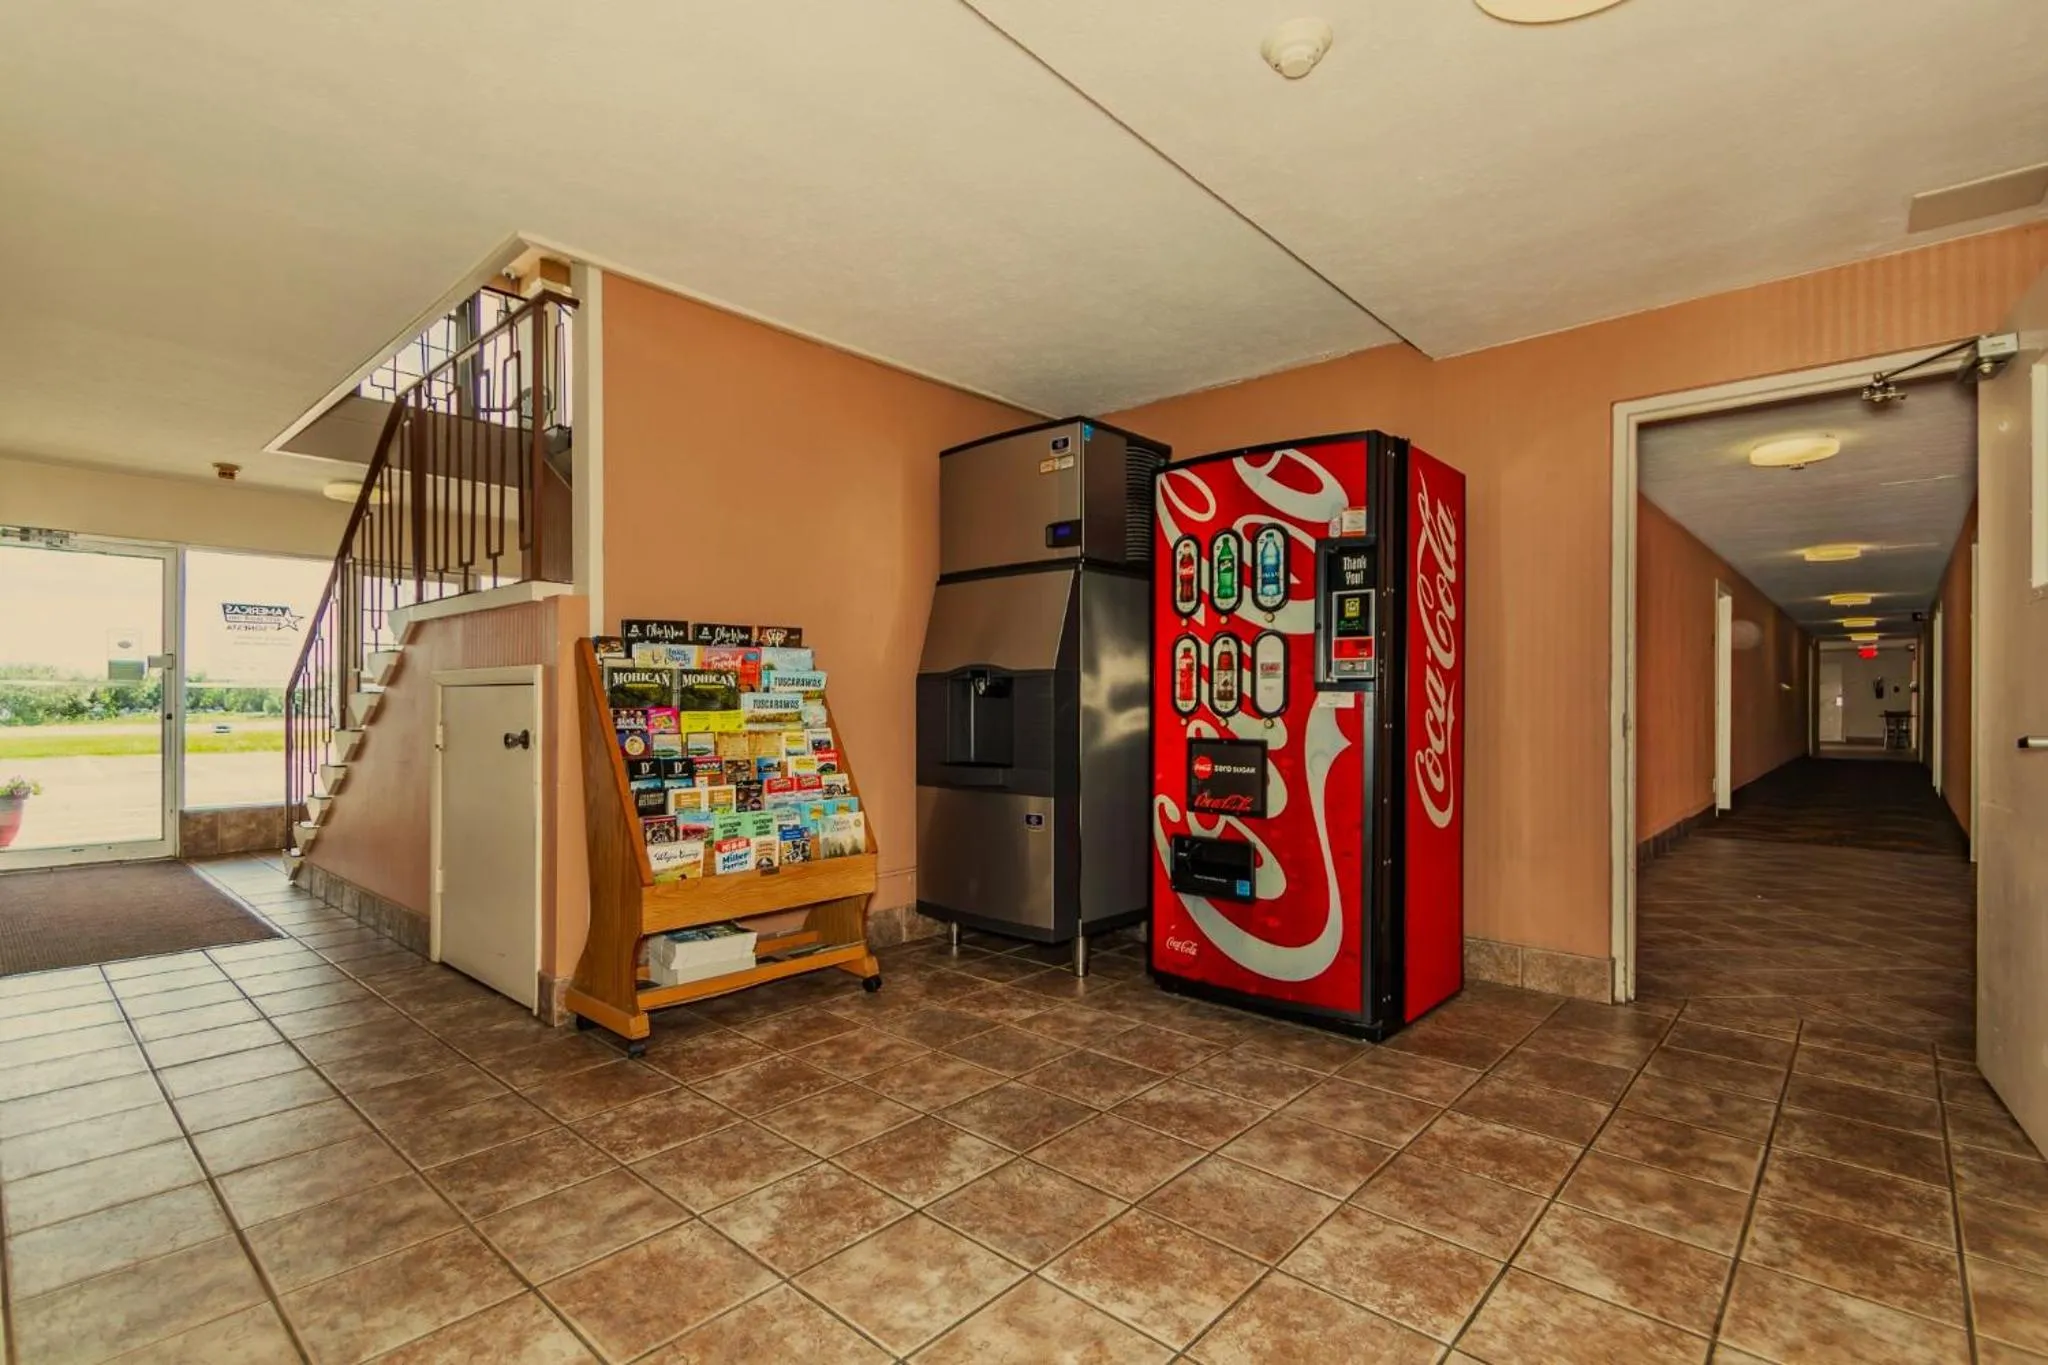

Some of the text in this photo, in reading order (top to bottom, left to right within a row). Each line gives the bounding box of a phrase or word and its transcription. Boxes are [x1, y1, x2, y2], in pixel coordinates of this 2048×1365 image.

[1343, 555, 1367, 571] Thank
[612, 670, 671, 687] MOHICAN
[682, 672, 736, 688] MOHICAN
[774, 676, 821, 688] TUSCARAWAS
[753, 698, 800, 709] TUSCARAWAS
[722, 851, 749, 864] Miller
[1166, 936, 1198, 956] Coca-Cola
